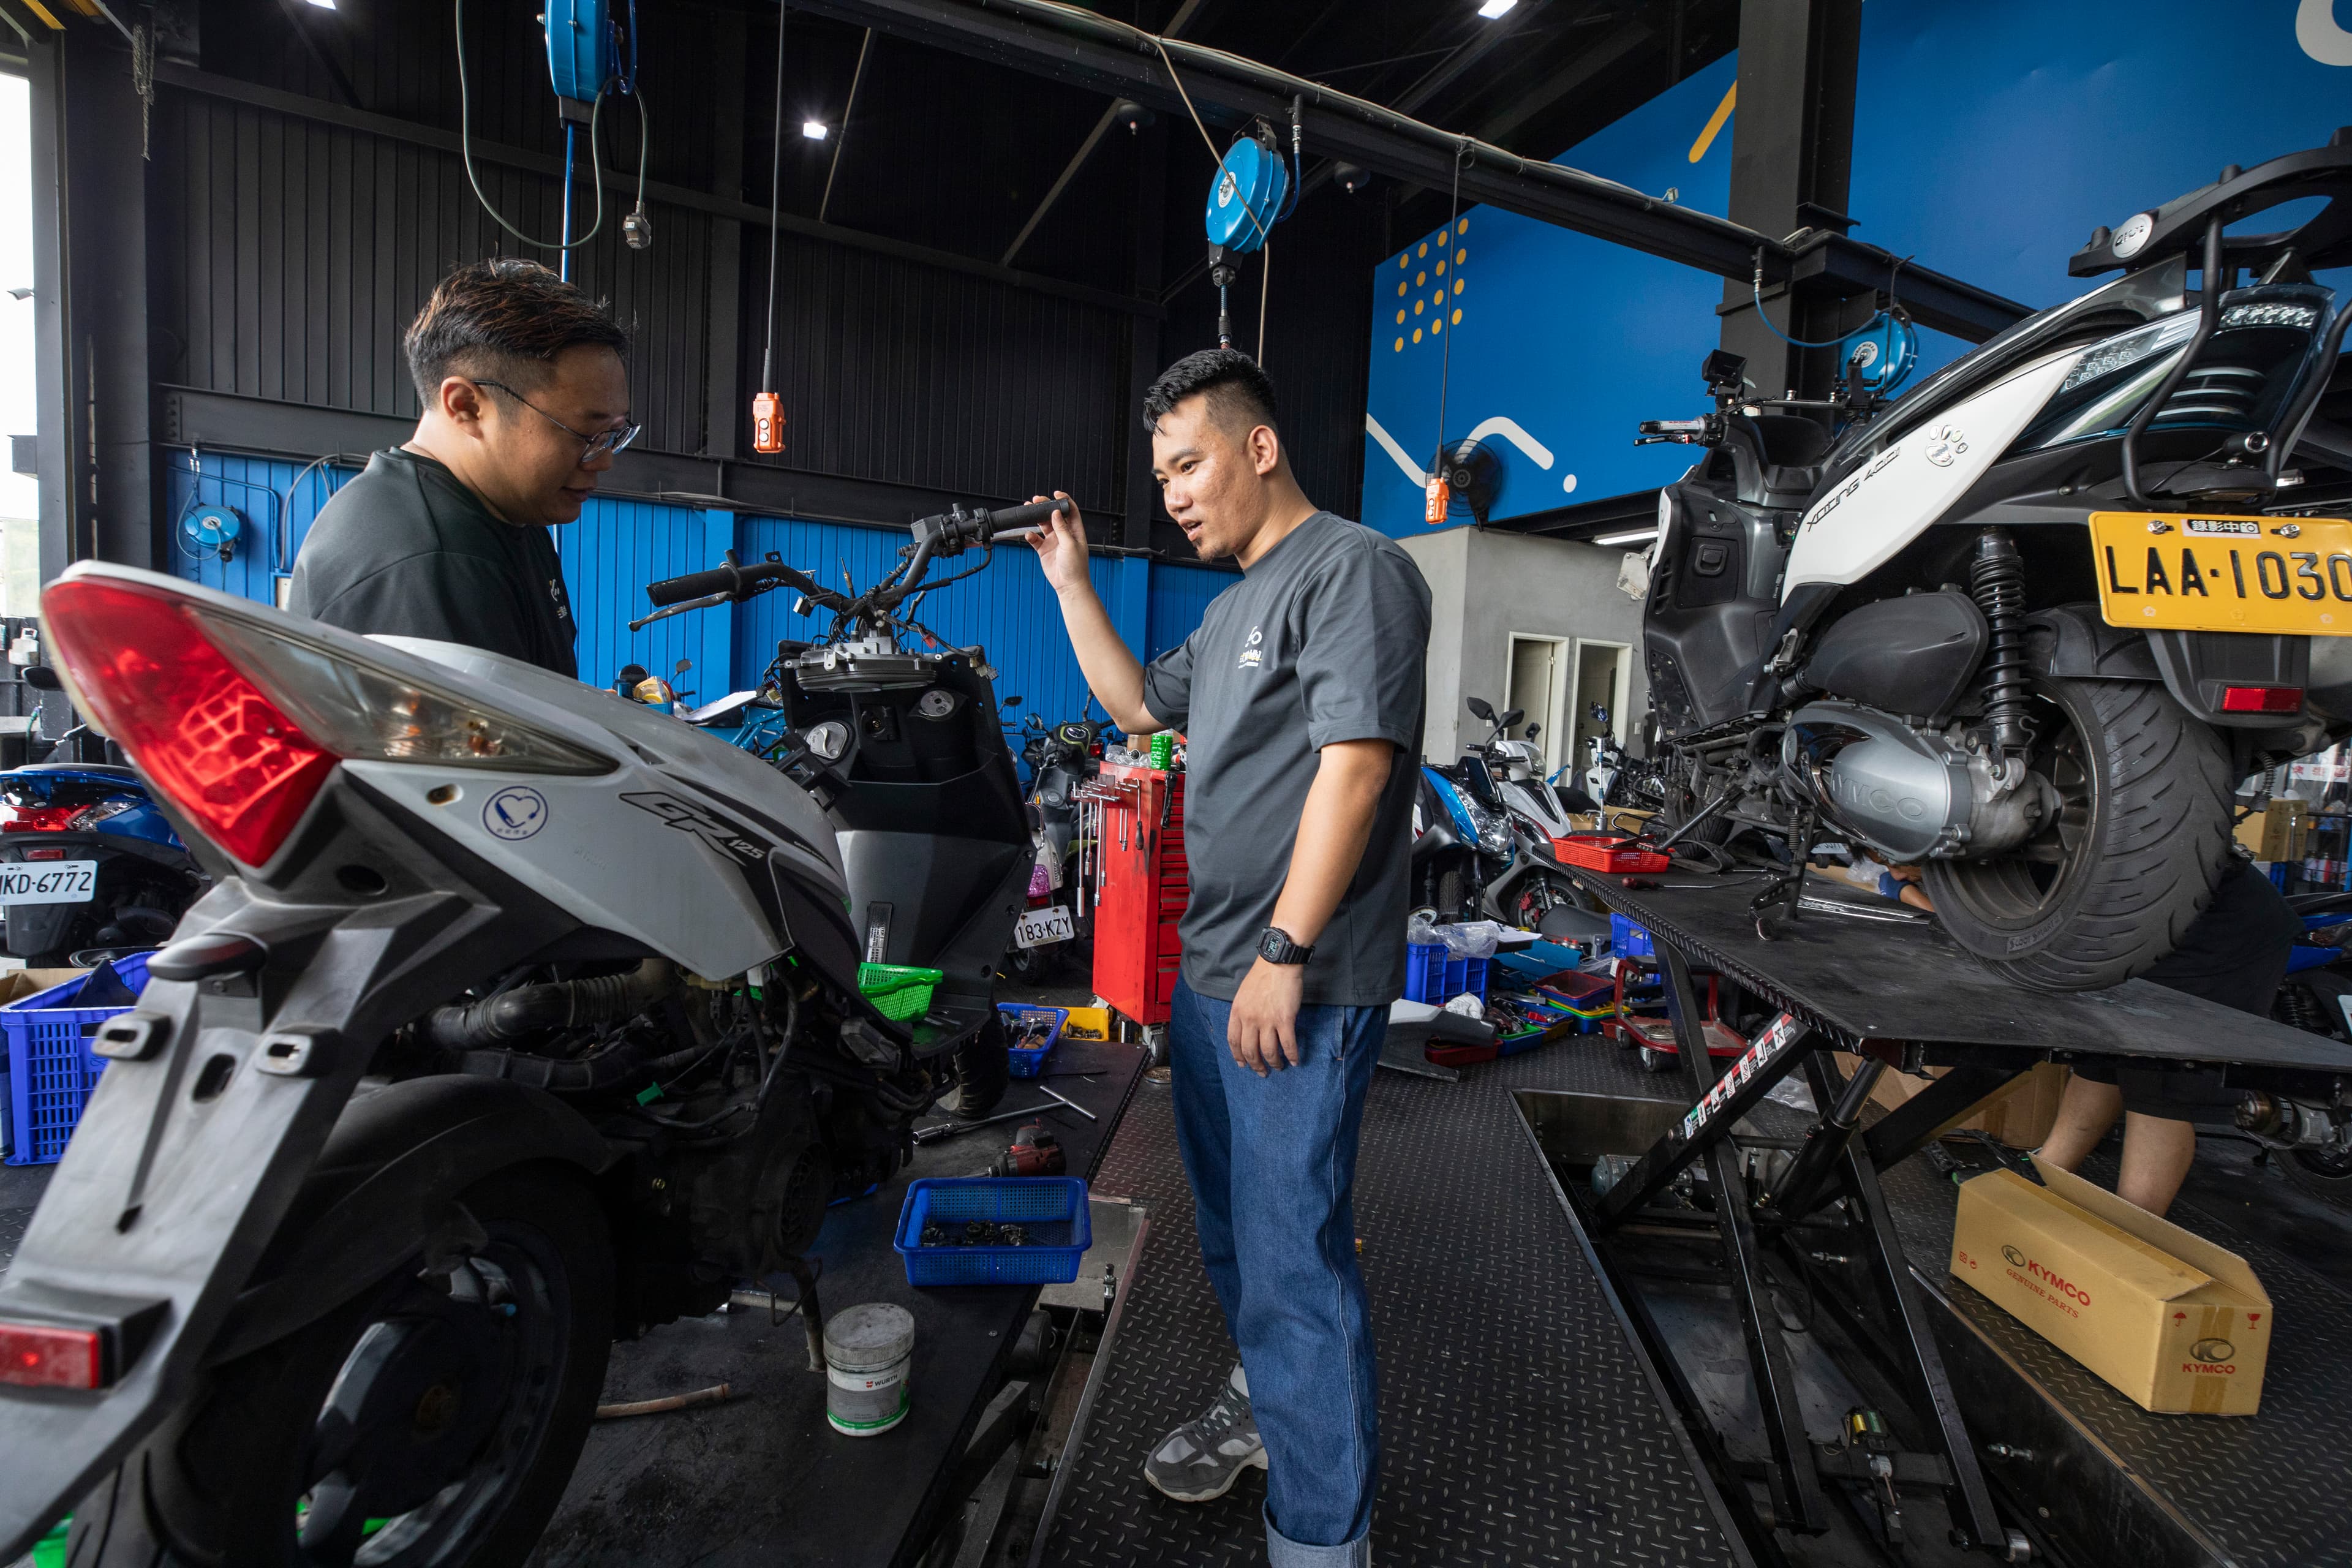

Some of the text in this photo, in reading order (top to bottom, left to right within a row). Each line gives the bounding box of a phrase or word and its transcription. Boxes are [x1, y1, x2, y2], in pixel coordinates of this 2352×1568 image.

[2007, 1268, 2079, 1318] GENUINE PARTS
[2027, 1259, 2092, 1306] KYMCO
[2182, 1363, 2236, 1374] KYMCO
